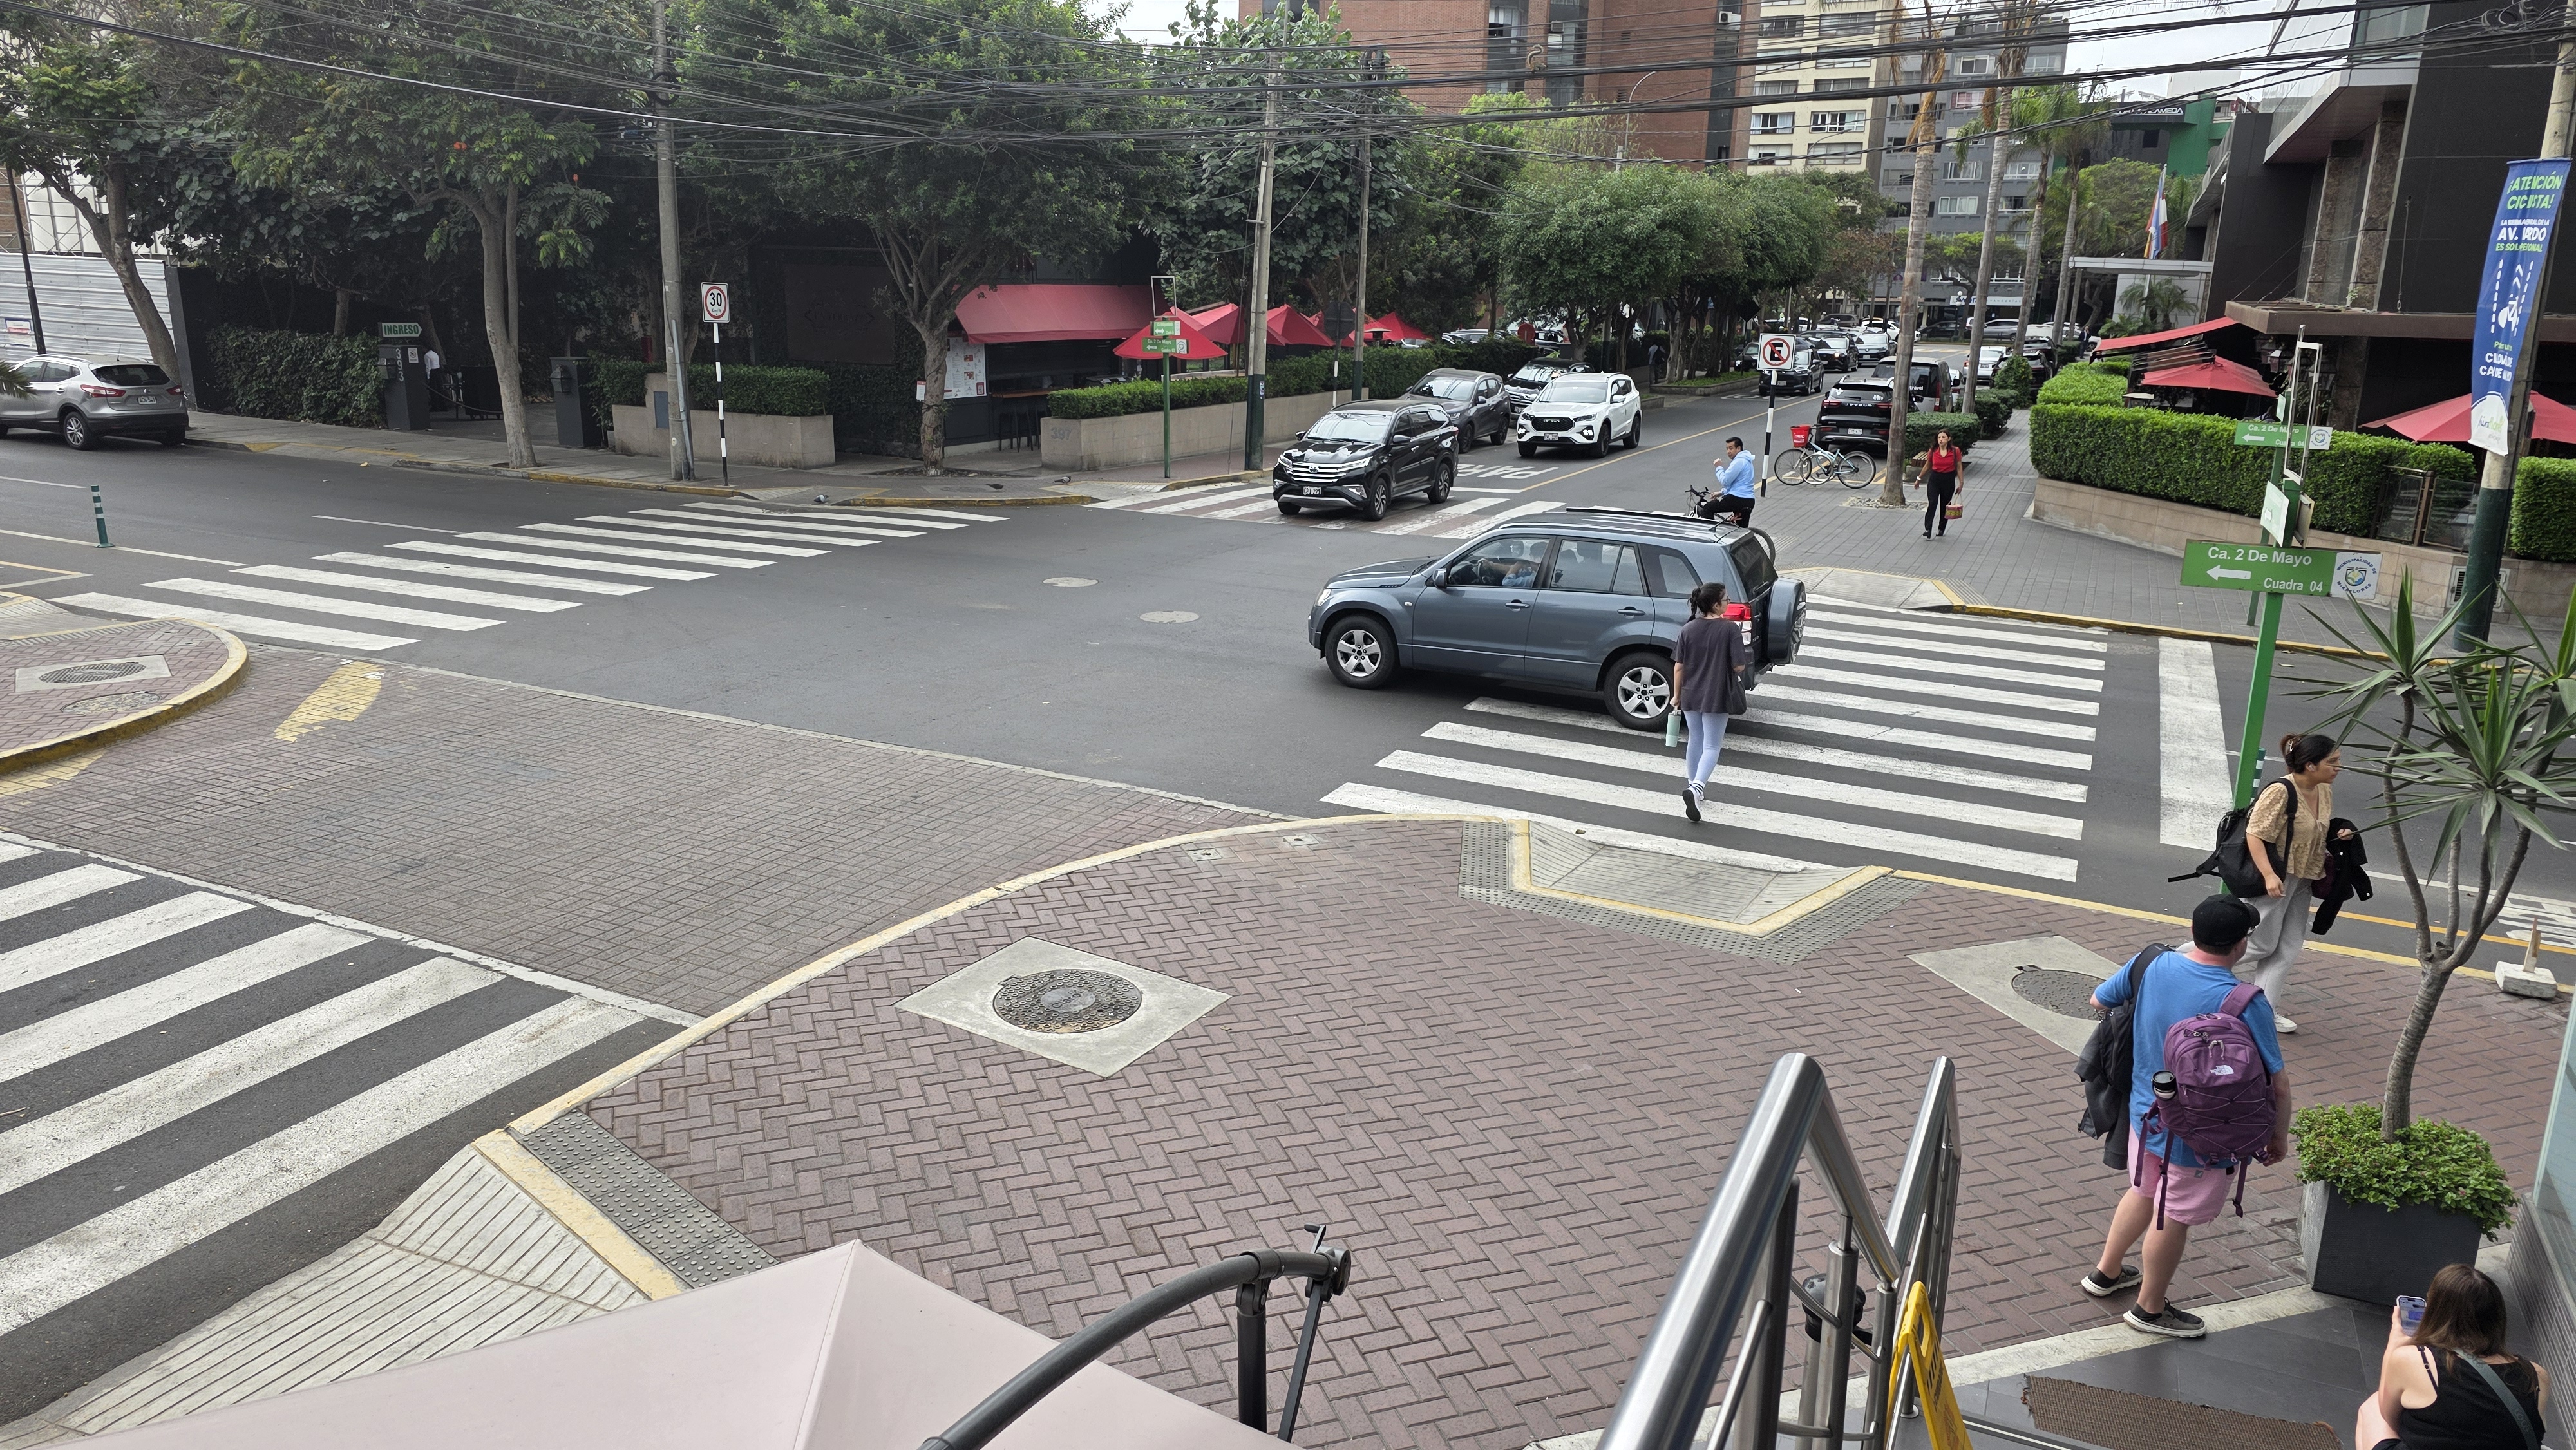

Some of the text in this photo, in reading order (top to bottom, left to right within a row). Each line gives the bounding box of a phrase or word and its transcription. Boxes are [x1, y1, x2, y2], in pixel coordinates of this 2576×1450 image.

[2497, 227, 2519, 241] AV.
[2496, 243, 2505, 252] ES
[710, 292, 722, 307] 30
[383, 325, 419, 335] INGRESO
[1770, 343, 1783, 361] E
[395, 348, 404, 382] 393
[2275, 438, 2296, 447] Cuaa
[2208, 546, 2313, 568] Ca. 2 De Mayo
[2336, 558, 2374, 571] MUNICIPALIDAD
[2264, 578, 2323, 592] Cuadra 04
[1052, 993, 1081, 1008] Claro
